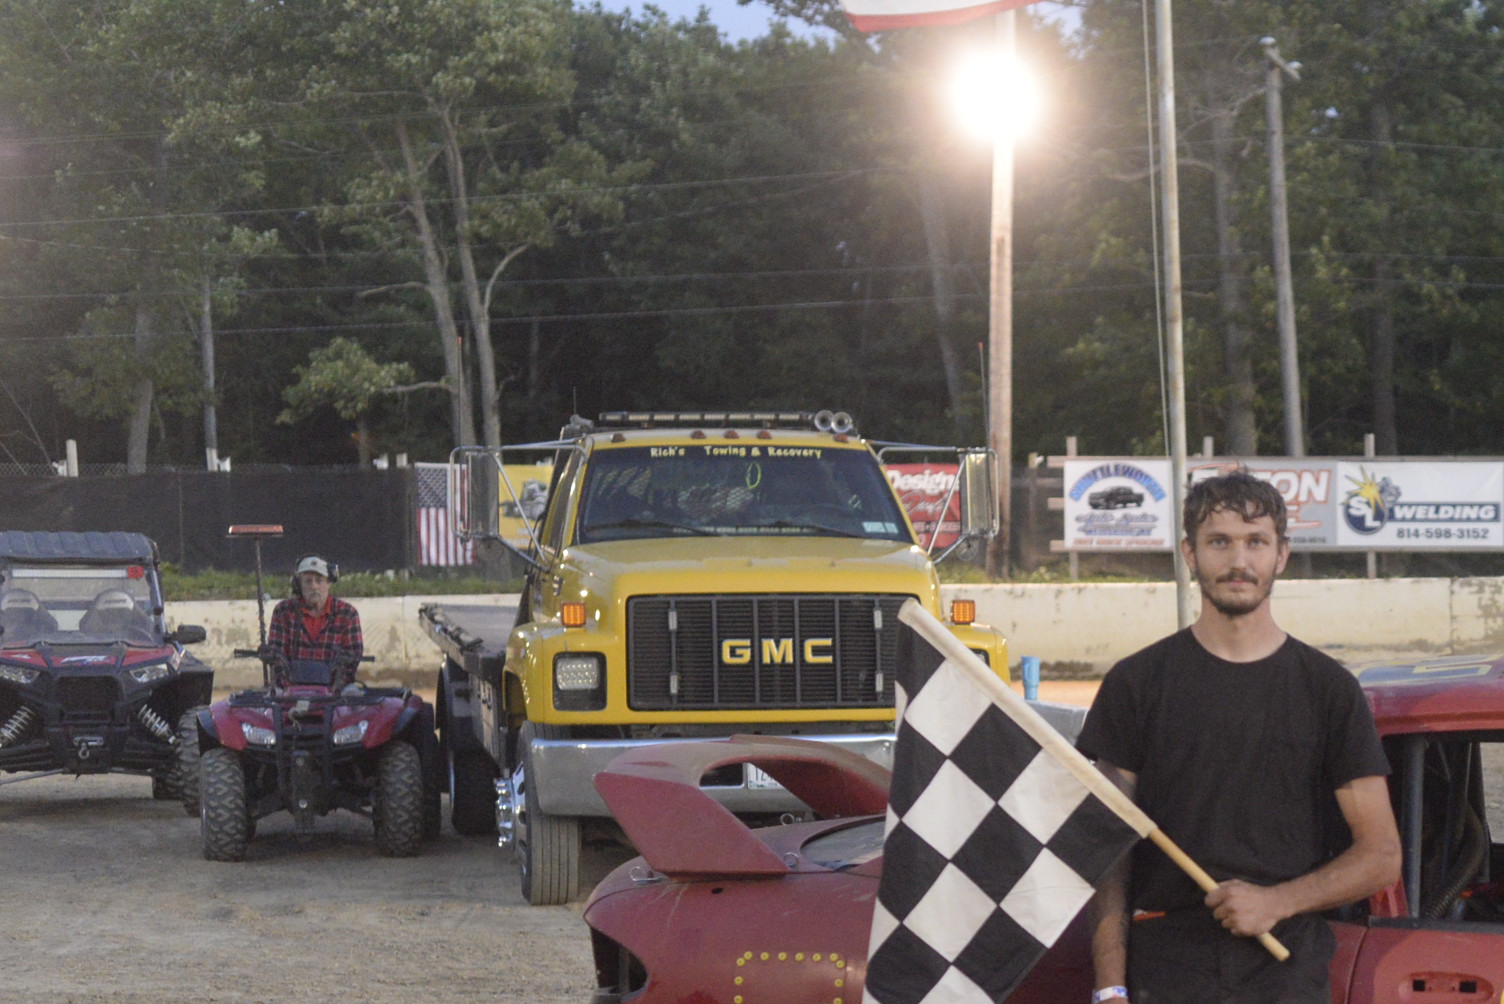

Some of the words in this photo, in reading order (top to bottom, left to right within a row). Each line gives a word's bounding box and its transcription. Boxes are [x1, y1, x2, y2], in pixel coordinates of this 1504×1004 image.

[650, 446, 686, 458] Rich's
[704, 445, 747, 457] Towing
[750, 446, 761, 456] &
[767, 446, 822, 460] Recovery
[1393, 504, 1496, 520] WELDING
[1397, 528, 1490, 539] 814-598-3152
[721, 637, 833, 664] GMC
